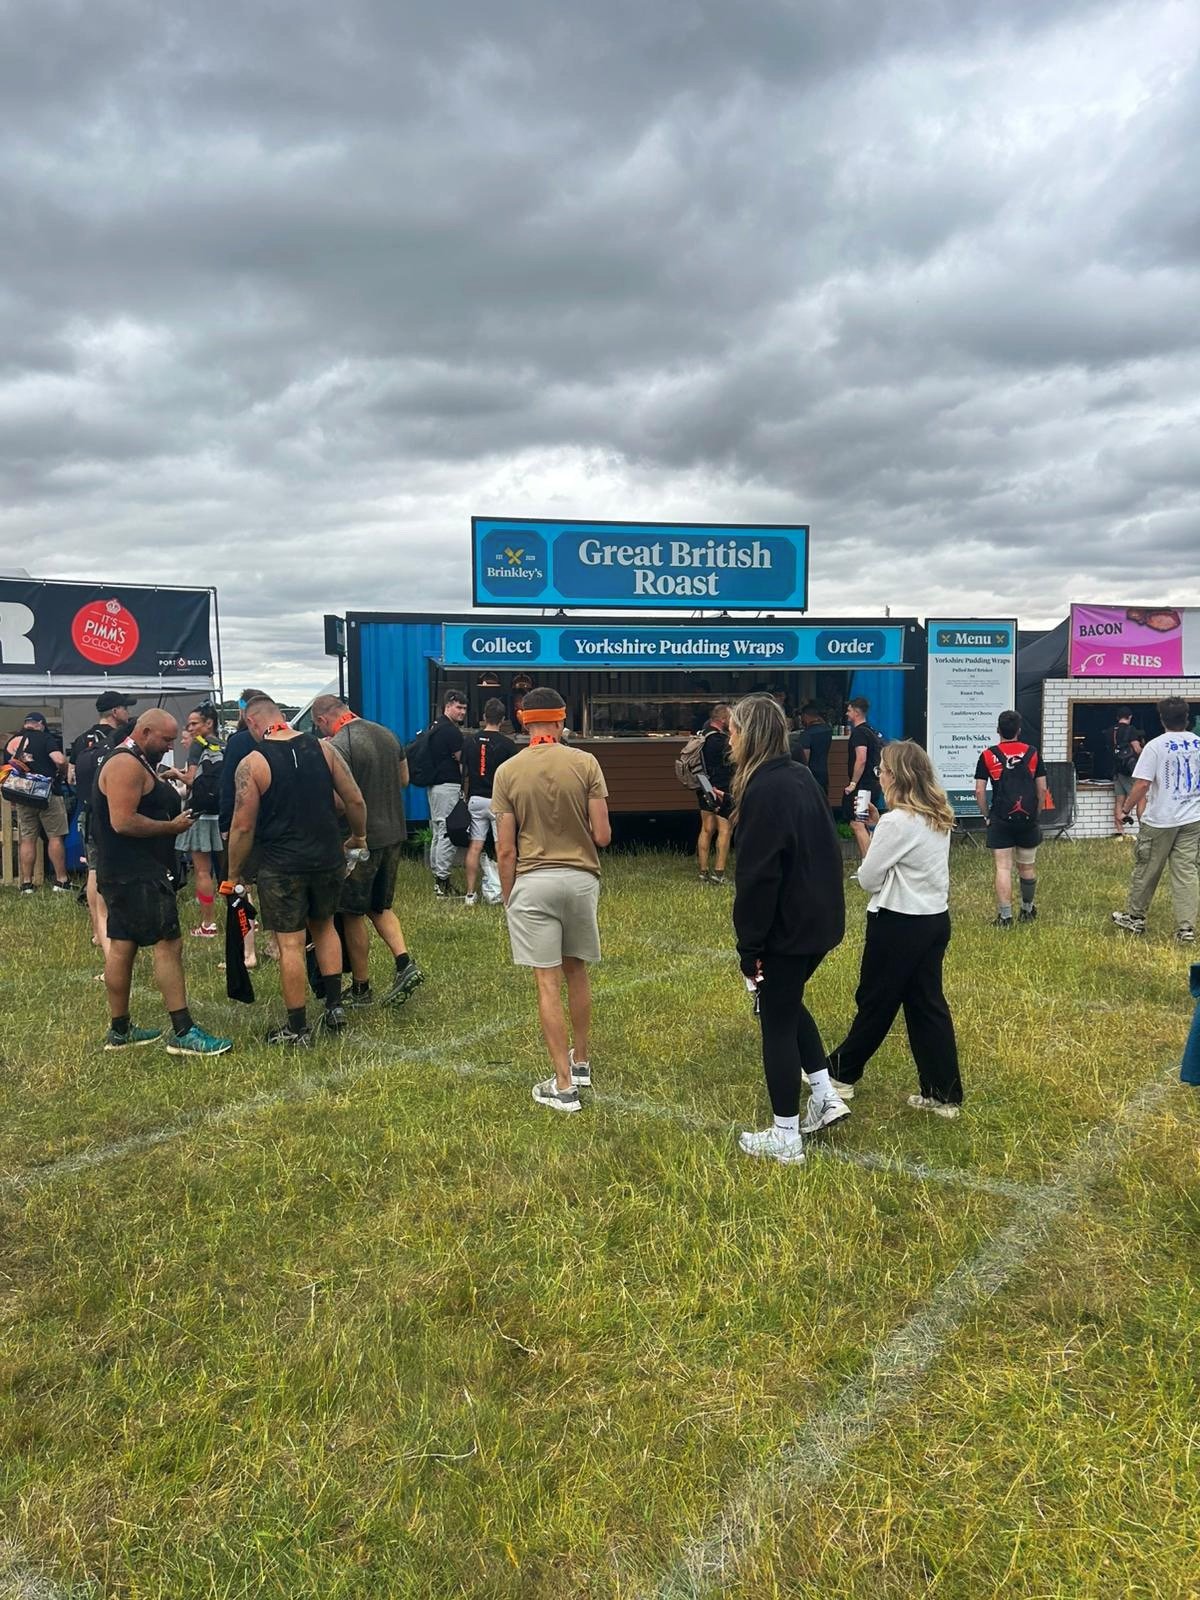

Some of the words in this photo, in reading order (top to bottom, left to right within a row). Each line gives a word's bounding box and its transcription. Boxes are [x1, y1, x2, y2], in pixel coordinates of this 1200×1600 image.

[578, 539, 665, 566] Great
[669, 540, 772, 568] British
[487, 567, 543, 580] Brinkley's
[633, 569, 720, 596] Roast
[101, 614, 118, 627] IT'S
[85, 619, 127, 645] PIMM'S
[1079, 623, 1123, 637] BACON
[81, 634, 124, 655] O'CLOCK!
[471, 637, 533, 654] Collect
[827, 638, 875, 654] Order
[955, 632, 992, 645] Menu
[574, 638, 657, 655] Yorkshire
[659, 638, 730, 658] Pudding
[732, 639, 785, 658] Wraps
[965, 657, 991, 665] Pudding
[991, 657, 1010, 665] Wraps
[1122, 653, 1163, 669] FRIES
